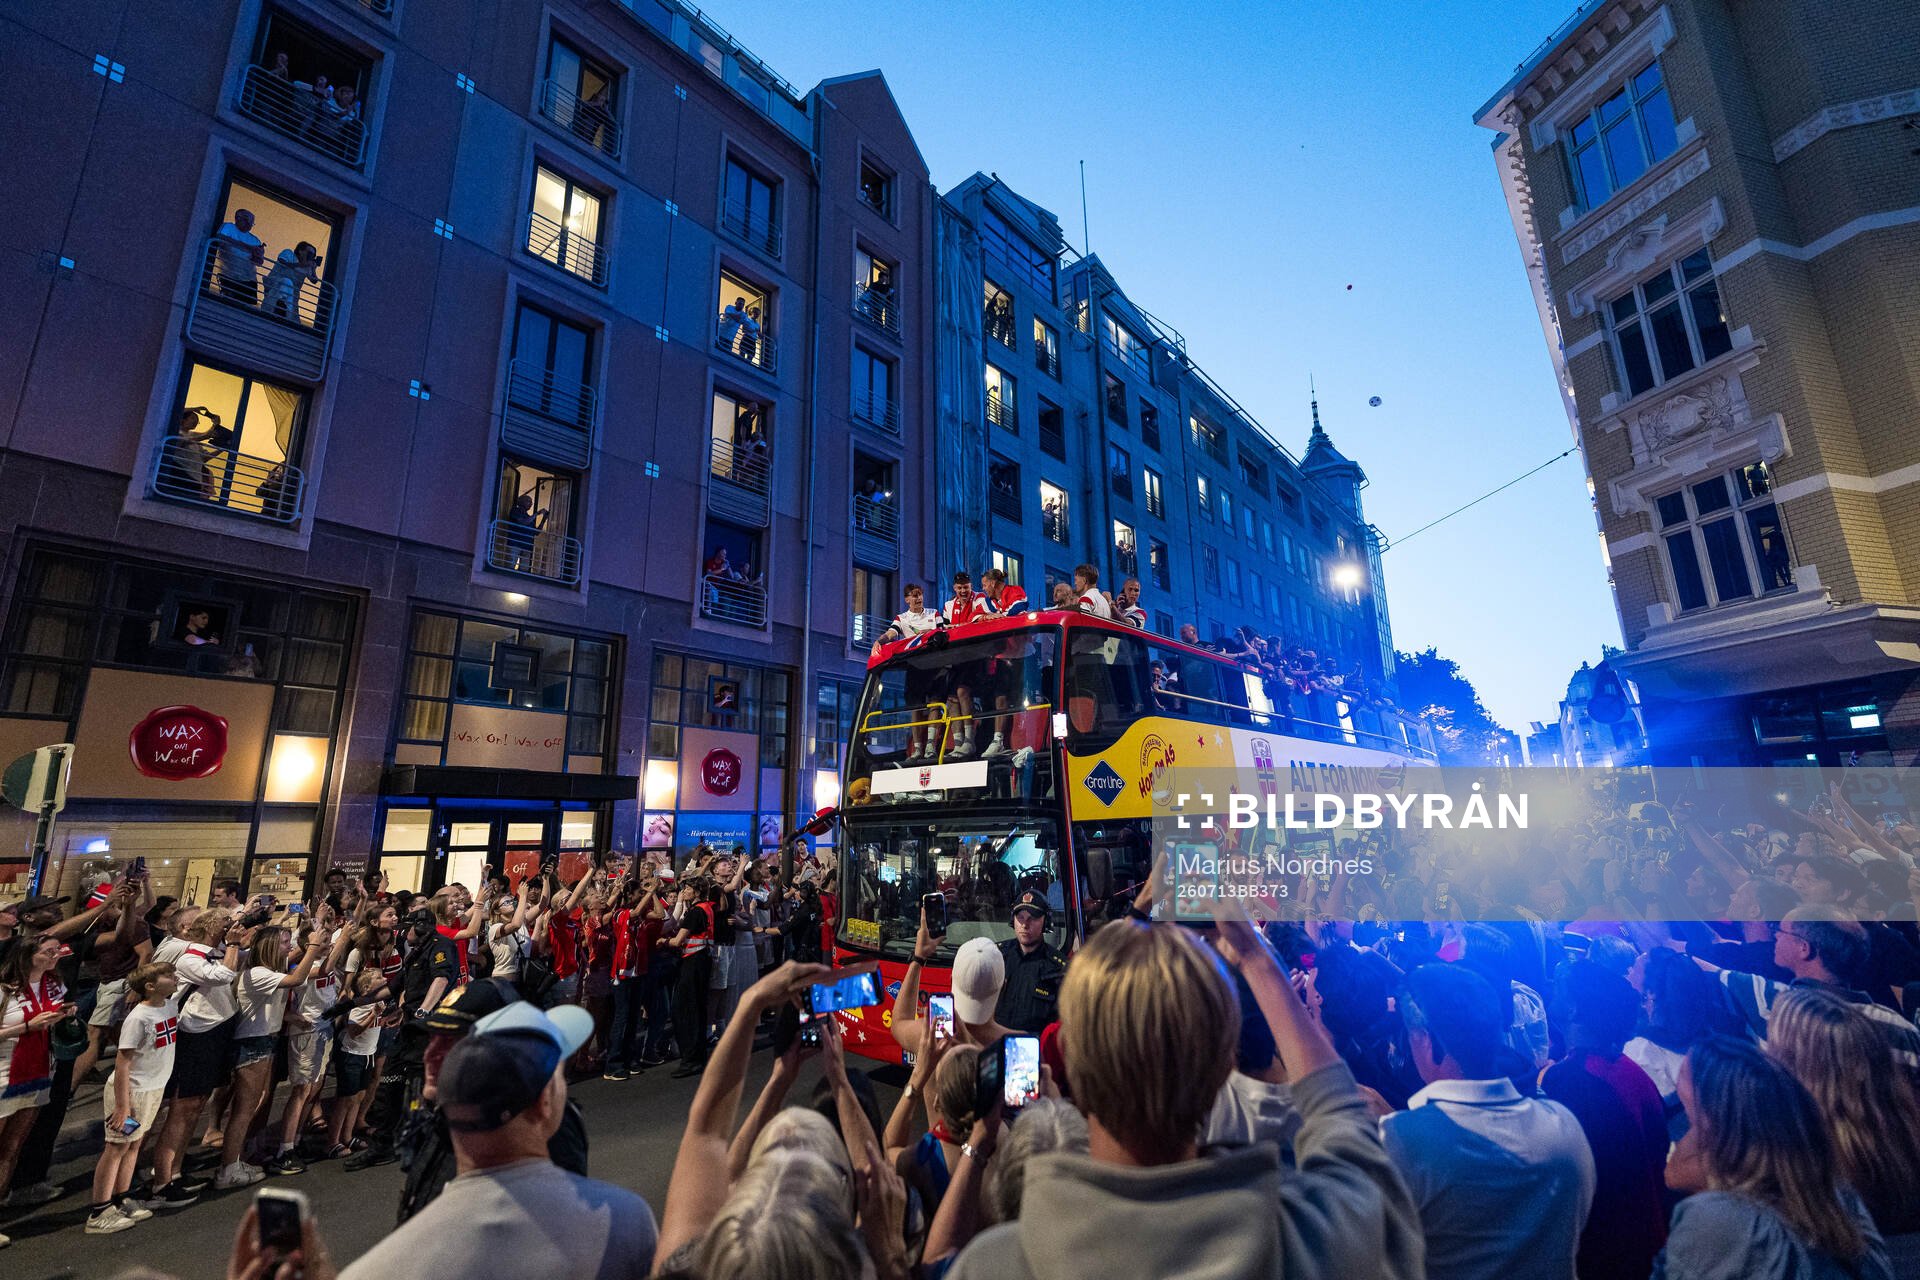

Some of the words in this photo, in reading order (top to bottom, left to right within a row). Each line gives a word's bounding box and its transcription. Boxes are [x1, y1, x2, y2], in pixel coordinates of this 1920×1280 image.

[159, 723, 203, 740] WAX
[454, 730, 479, 744] Wax
[486, 733, 508, 746] On!
[515, 736, 538, 747] Wax
[544, 737, 562, 748] Off
[1138, 771, 1156, 799] HOP
[1164, 743, 1176, 768] AS
[1290, 759, 1318, 793] ALT
[1319, 762, 1350, 794] FOR
[512, 862, 529, 876] Off
